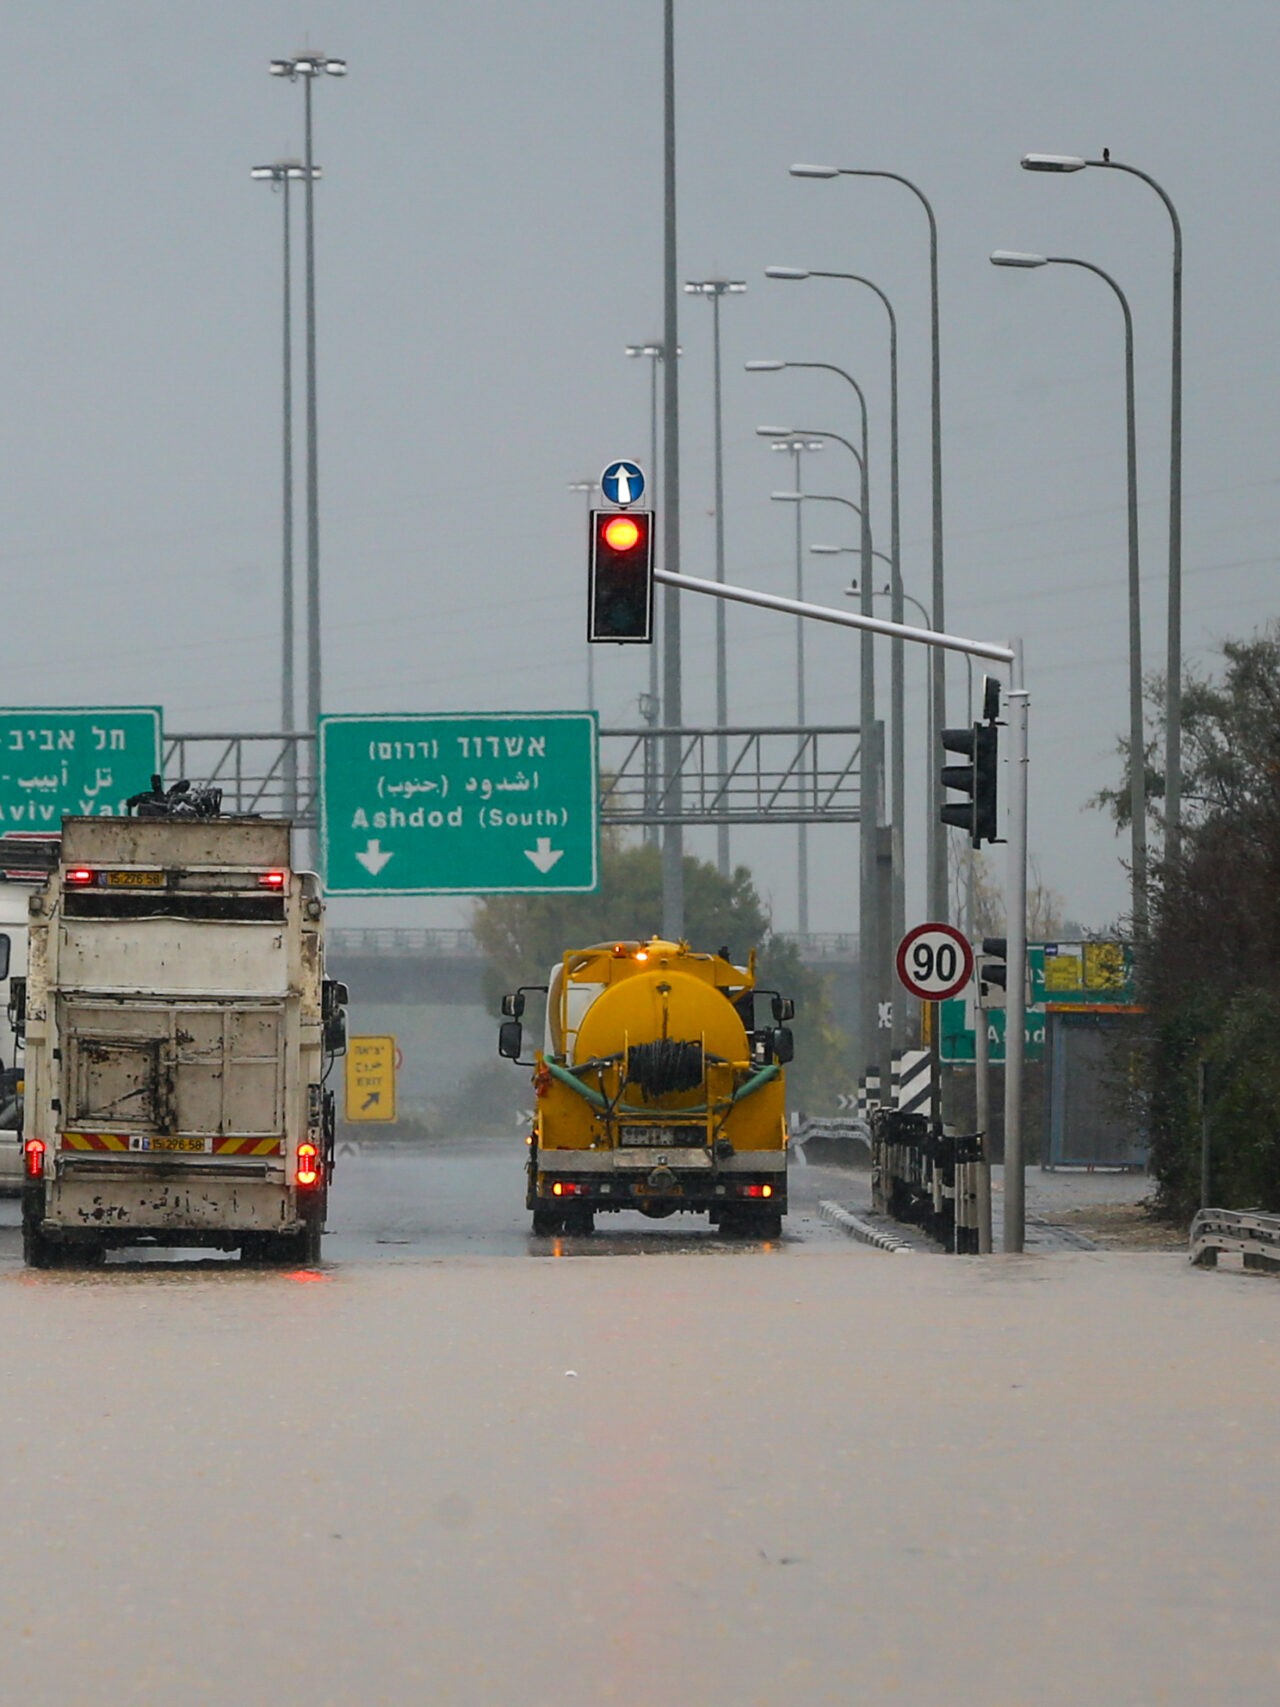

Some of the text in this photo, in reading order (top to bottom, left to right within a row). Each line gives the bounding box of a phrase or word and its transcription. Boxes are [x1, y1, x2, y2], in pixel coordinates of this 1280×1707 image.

[91, 725, 126, 751] תל
[369, 735, 547, 761] אשדוד (דרום)
[83, 767, 113, 796] تل
[376, 775, 449, 798] (جنوب)
[351, 806, 568, 829] Ashdod (South)
[913, 943, 957, 982] 90
